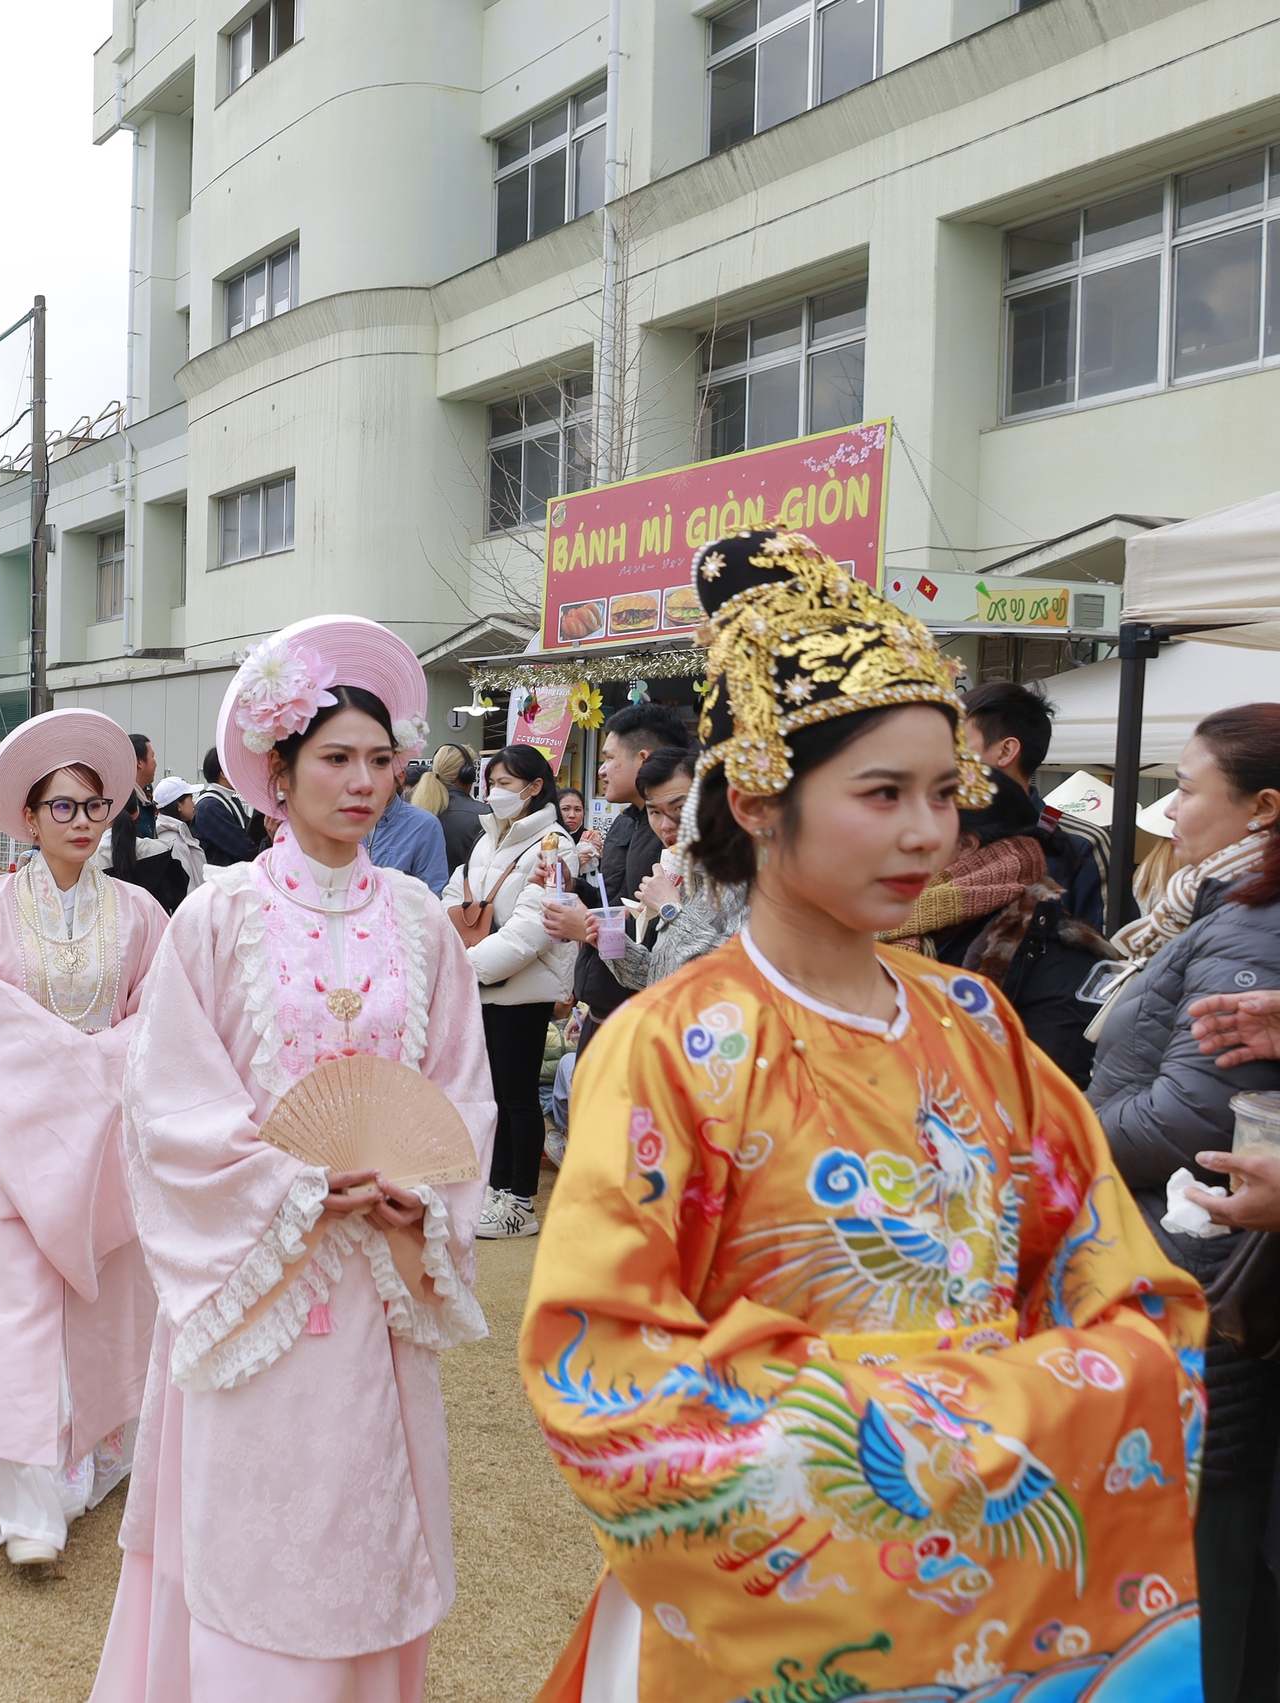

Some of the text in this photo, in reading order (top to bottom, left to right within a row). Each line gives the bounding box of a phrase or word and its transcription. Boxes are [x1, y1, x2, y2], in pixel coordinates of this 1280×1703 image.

[552, 468, 870, 573] BÁNH MÌ GIÒN GIÒN
